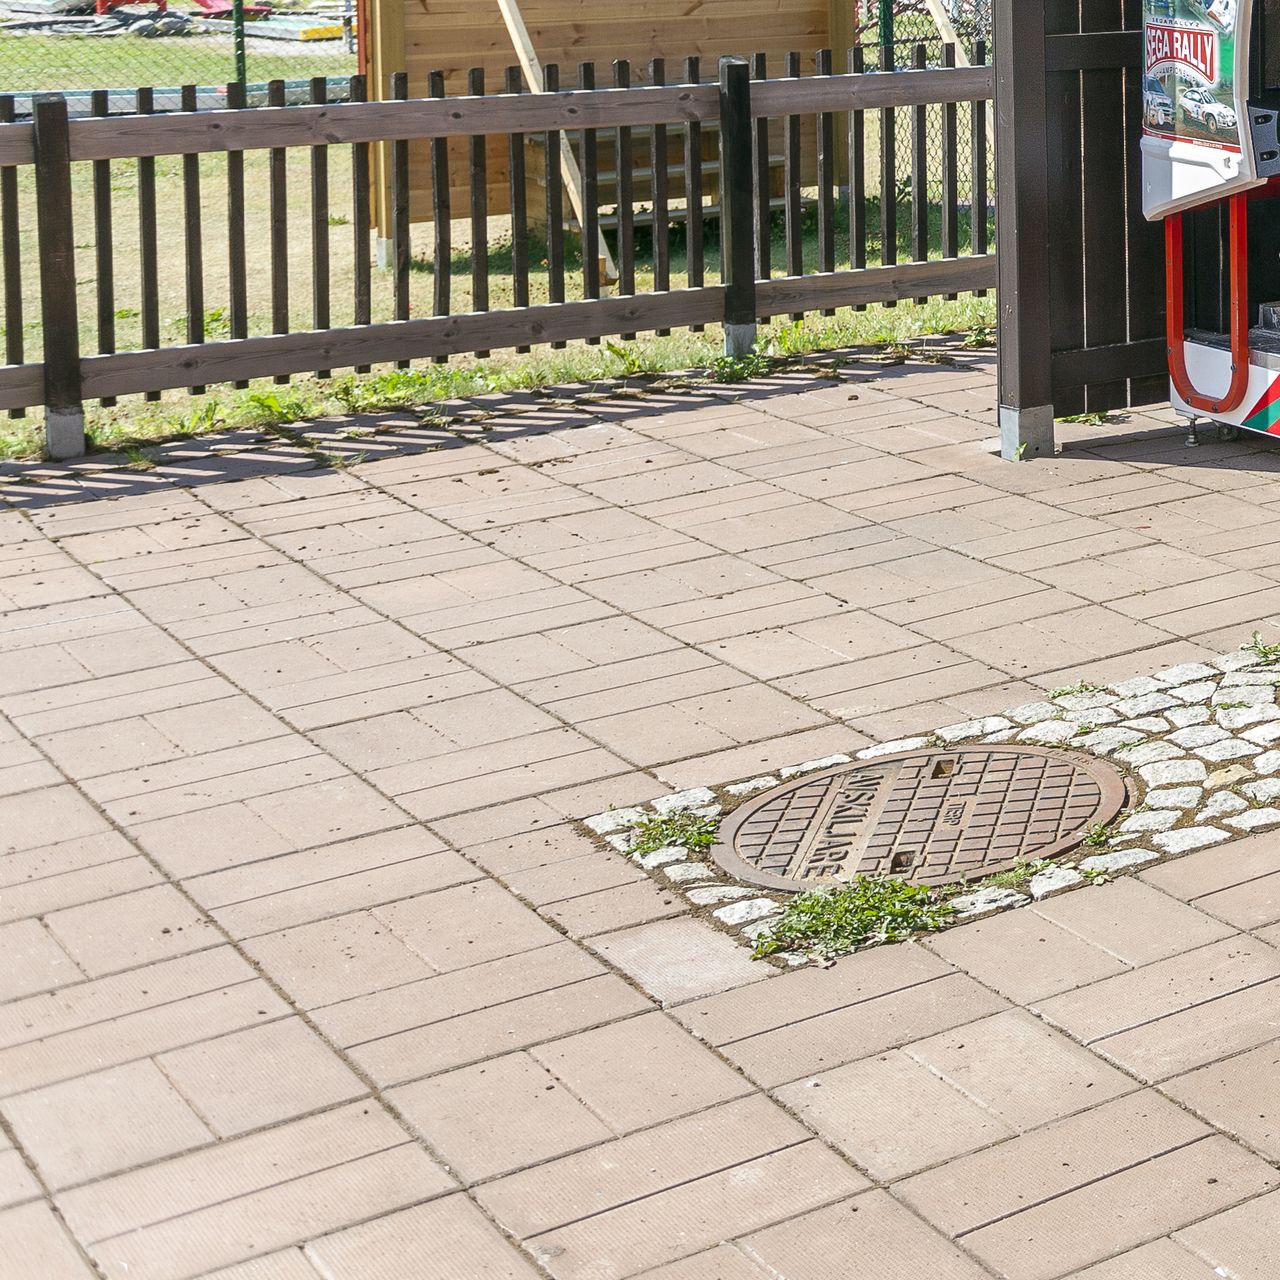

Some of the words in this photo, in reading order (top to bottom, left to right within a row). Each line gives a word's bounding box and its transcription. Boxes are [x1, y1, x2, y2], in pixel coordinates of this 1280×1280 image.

[1146, 26, 1170, 68] SEGA
[1173, 31, 1213, 77] RALLY
[801, 773, 885, 879] AVSKILJARE
